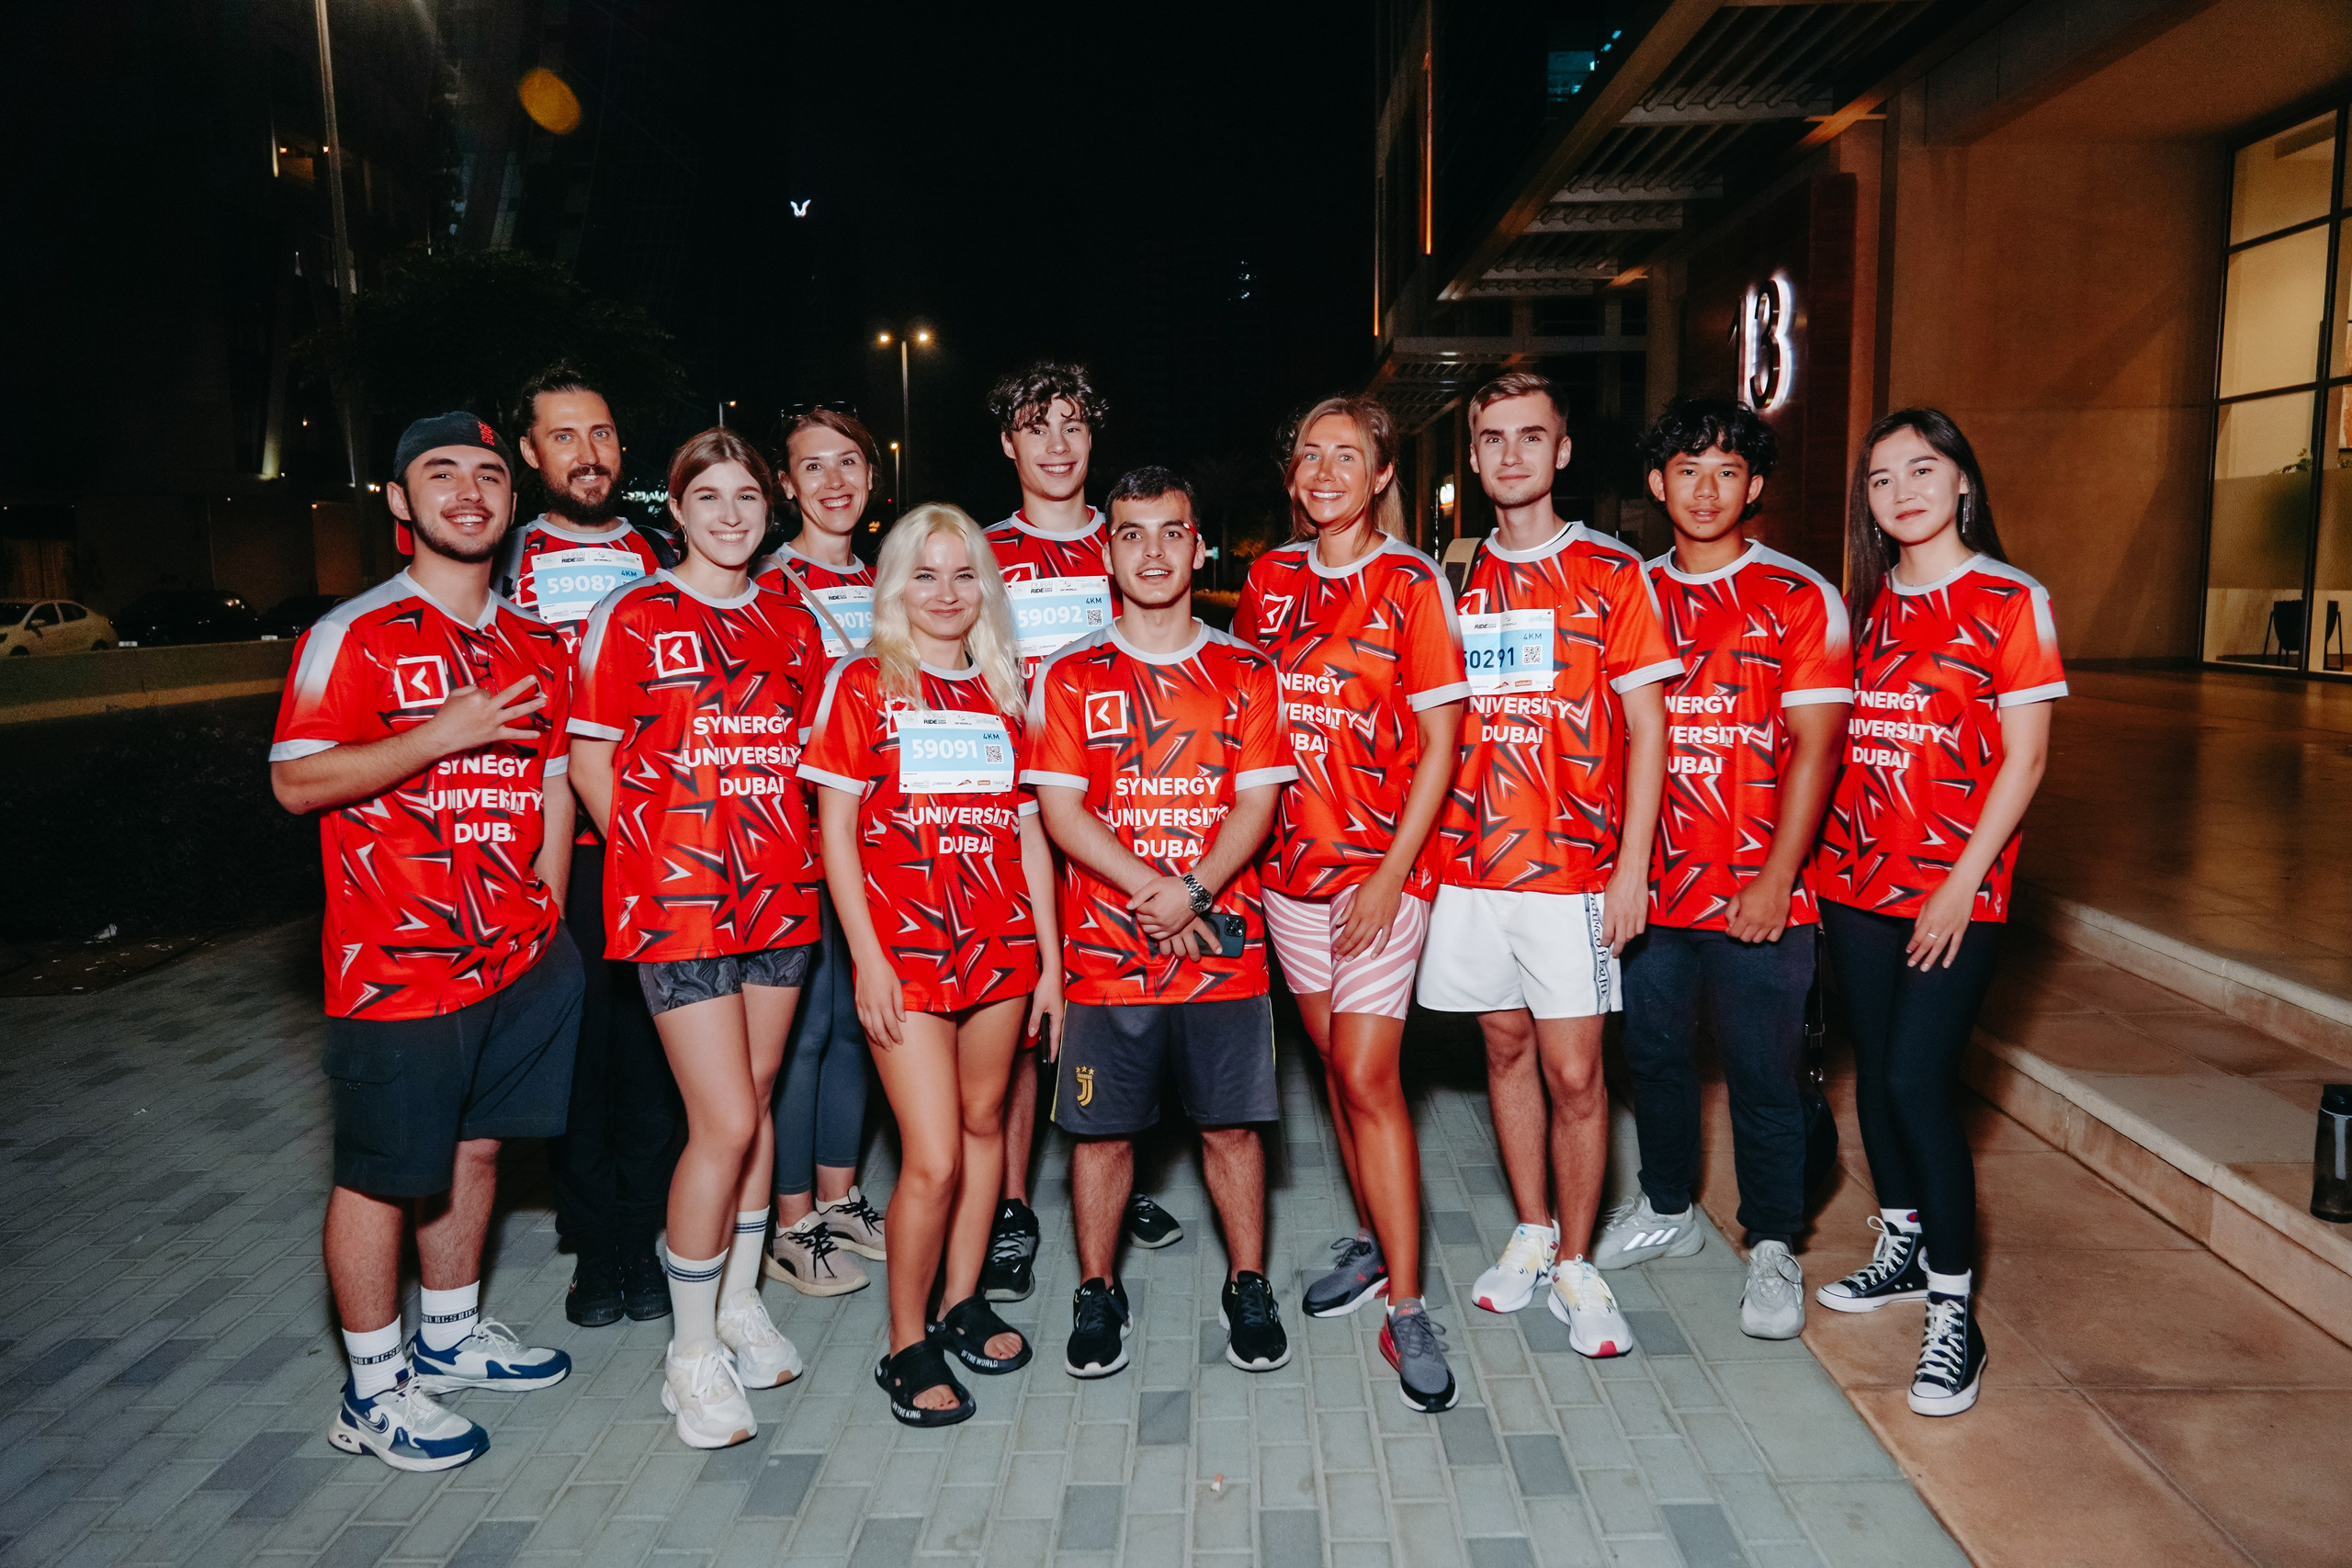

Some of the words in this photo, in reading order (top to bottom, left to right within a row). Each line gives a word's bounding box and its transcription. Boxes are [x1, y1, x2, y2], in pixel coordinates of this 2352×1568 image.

[547, 575, 616, 595] 59082
[822, 611, 873, 630] 9079
[1017, 605, 1083, 628] 59092
[1279, 672, 1346, 696] NERGY
[1664, 695, 1737, 714] NERGY
[1853, 690, 1931, 712] NERGY
[693, 716, 793, 735] SYNERGY
[1283, 702, 1360, 729] ERSITY
[1481, 725, 1544, 744] DUBAI
[1668, 725, 1754, 745] ERSITY
[1848, 718, 1947, 743] IVERSITY
[911, 739, 978, 759] 59091
[1290, 732, 1329, 754] BAI
[437, 754, 531, 778] SYNEGY
[683, 746, 802, 768] UNIVERSIY
[1667, 756, 1723, 774] UBAI
[1852, 746, 1911, 769] DUBAI
[719, 776, 785, 796] DUBAI
[1115, 777, 1222, 796] SYNERGY
[909, 806, 1013, 826] UNIVERSIT
[1109, 807, 1228, 828] UNIVERSITY
[454, 822, 516, 843] DUB
[939, 836, 993, 854] DUBAI
[1133, 839, 1204, 858] DUBAI
[976, 1357, 999, 1368] WORLD
